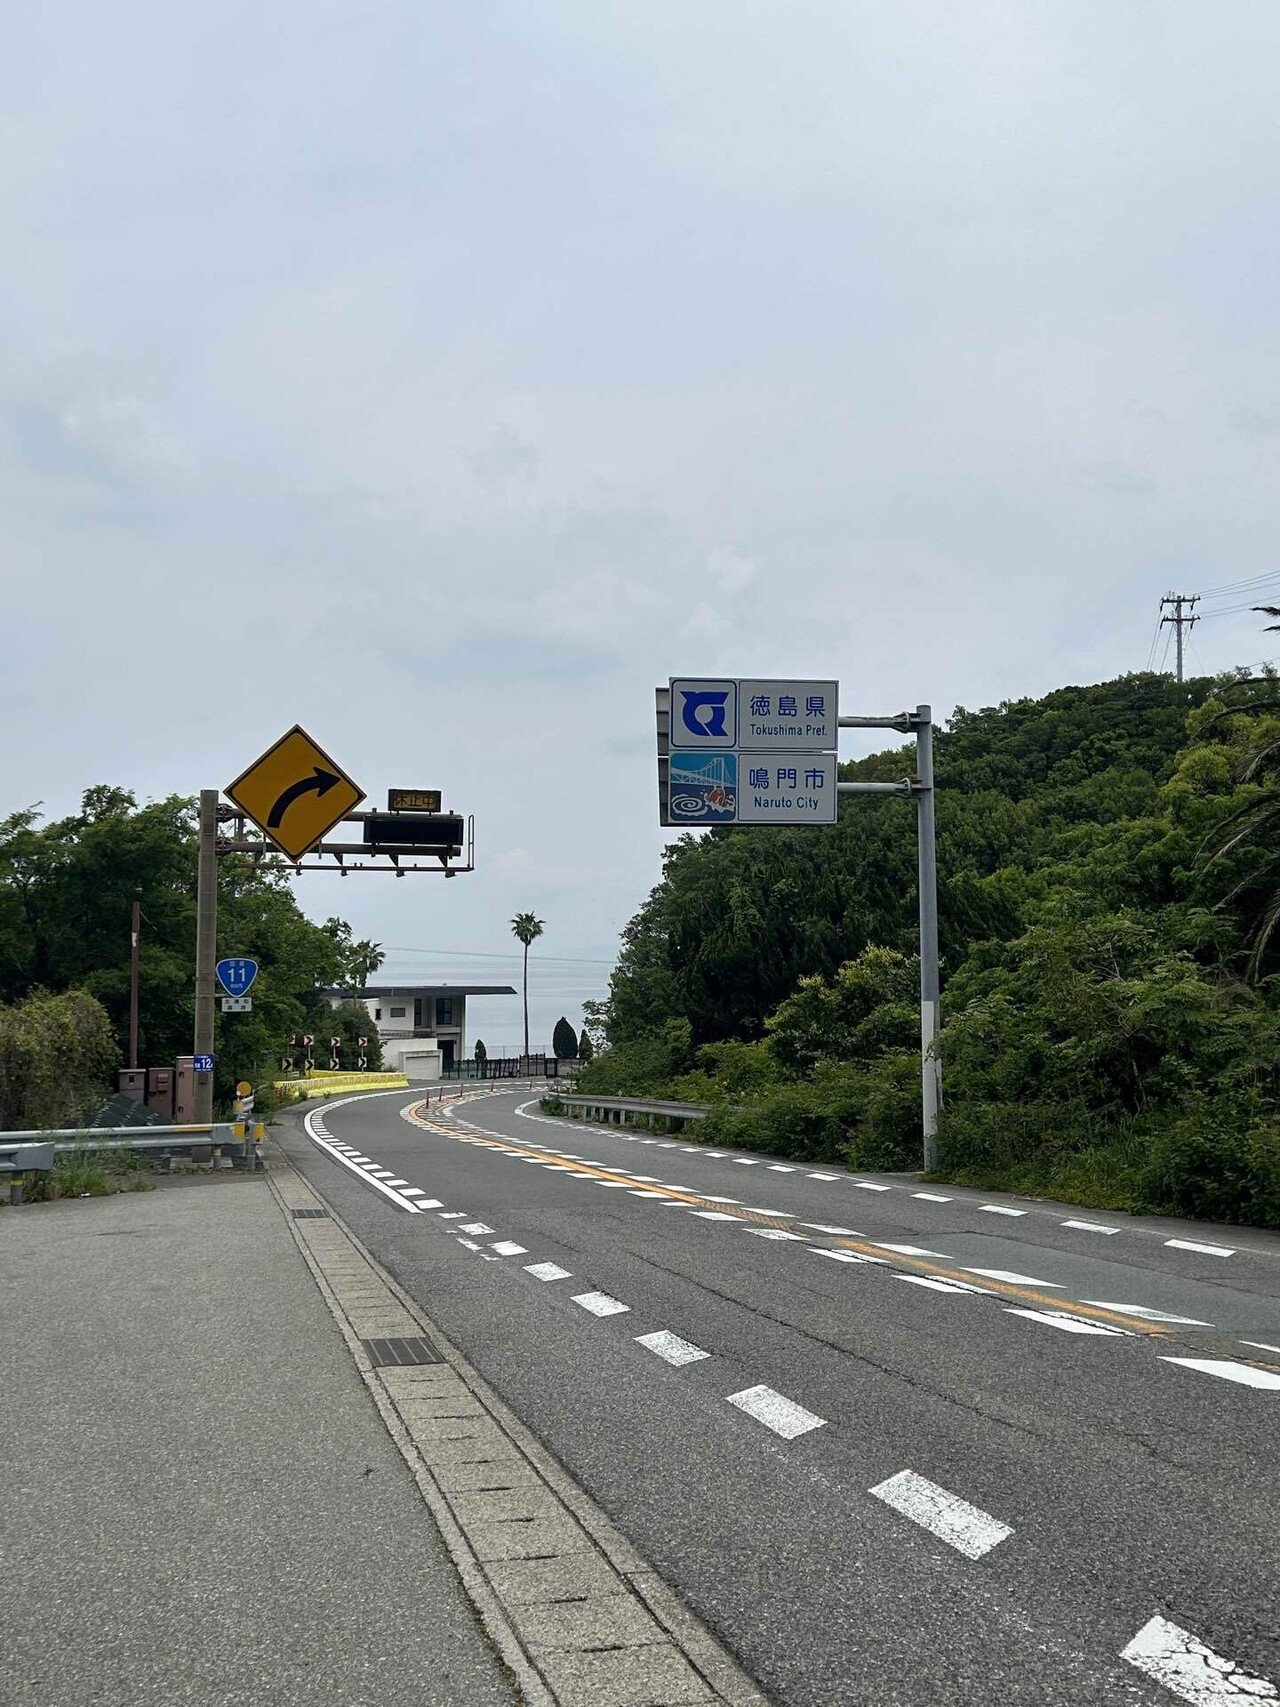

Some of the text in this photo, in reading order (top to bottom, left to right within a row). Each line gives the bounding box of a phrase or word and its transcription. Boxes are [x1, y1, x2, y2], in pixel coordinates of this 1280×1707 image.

[750, 695, 825, 717] 徳島県
[750, 723, 827, 736] Tokushima Pref.
[749, 768, 825, 789] 鳴門市
[754, 796, 819, 810] Naruto City
[227, 968, 246, 982] 11
